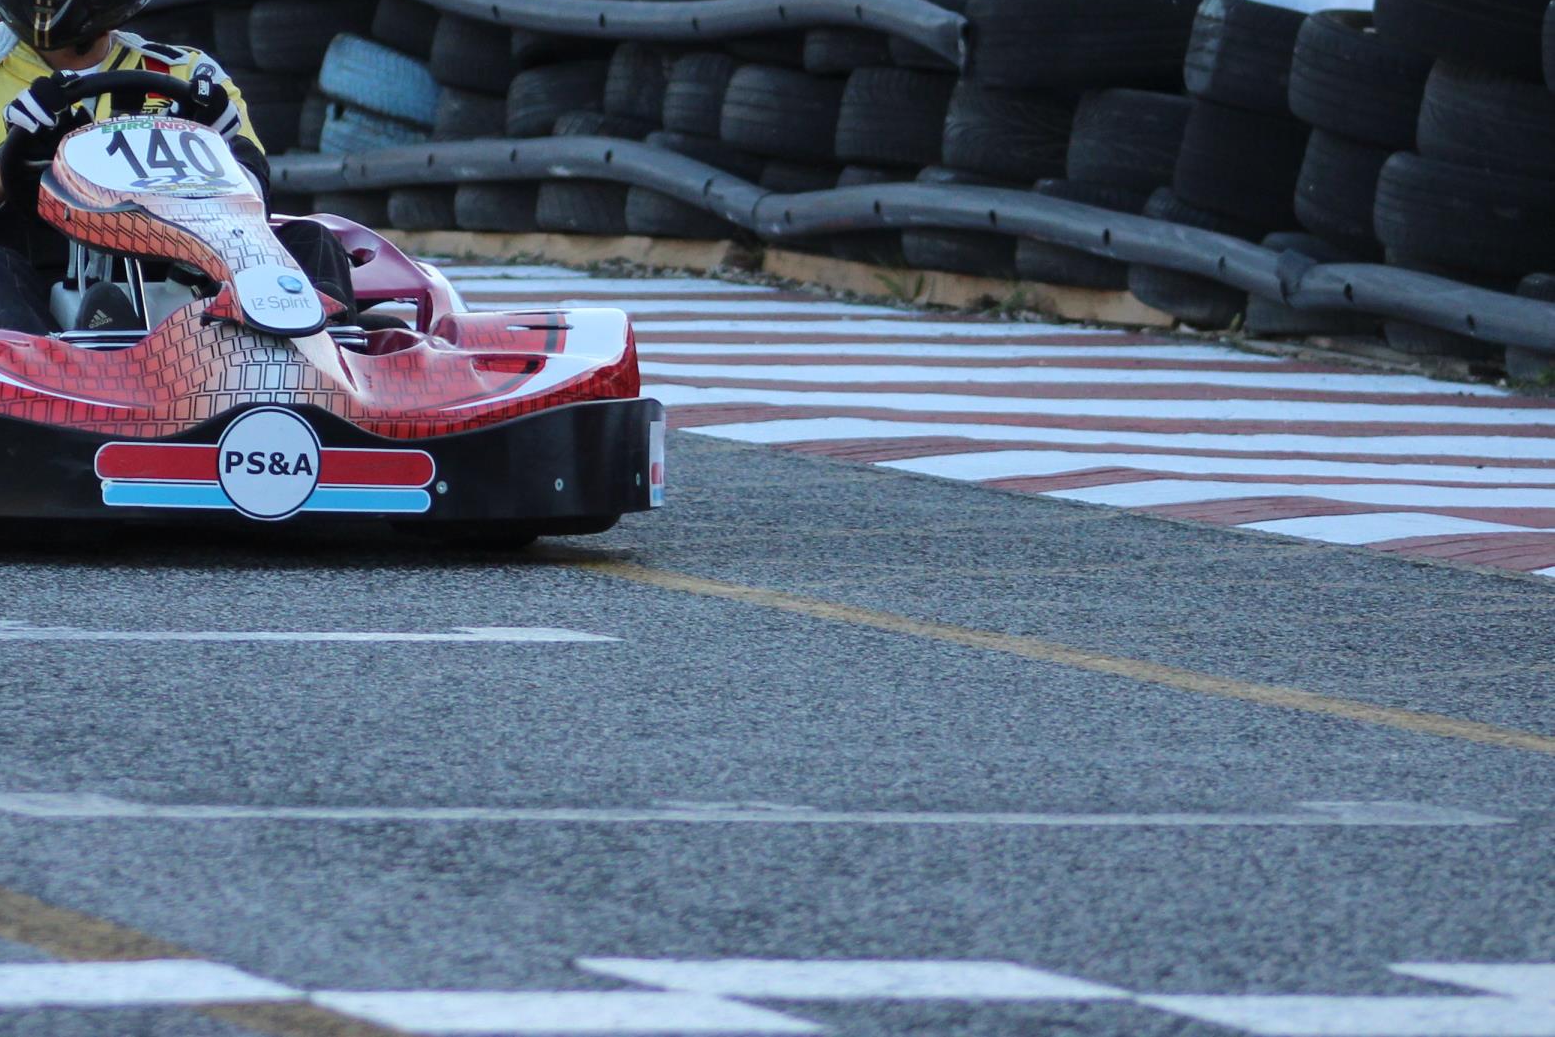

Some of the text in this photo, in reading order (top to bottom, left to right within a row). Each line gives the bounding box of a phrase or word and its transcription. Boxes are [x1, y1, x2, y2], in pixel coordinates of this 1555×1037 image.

[106, 128, 225, 179] 140
[267, 296, 312, 311] Spirit
[225, 451, 313, 476] PS&A
